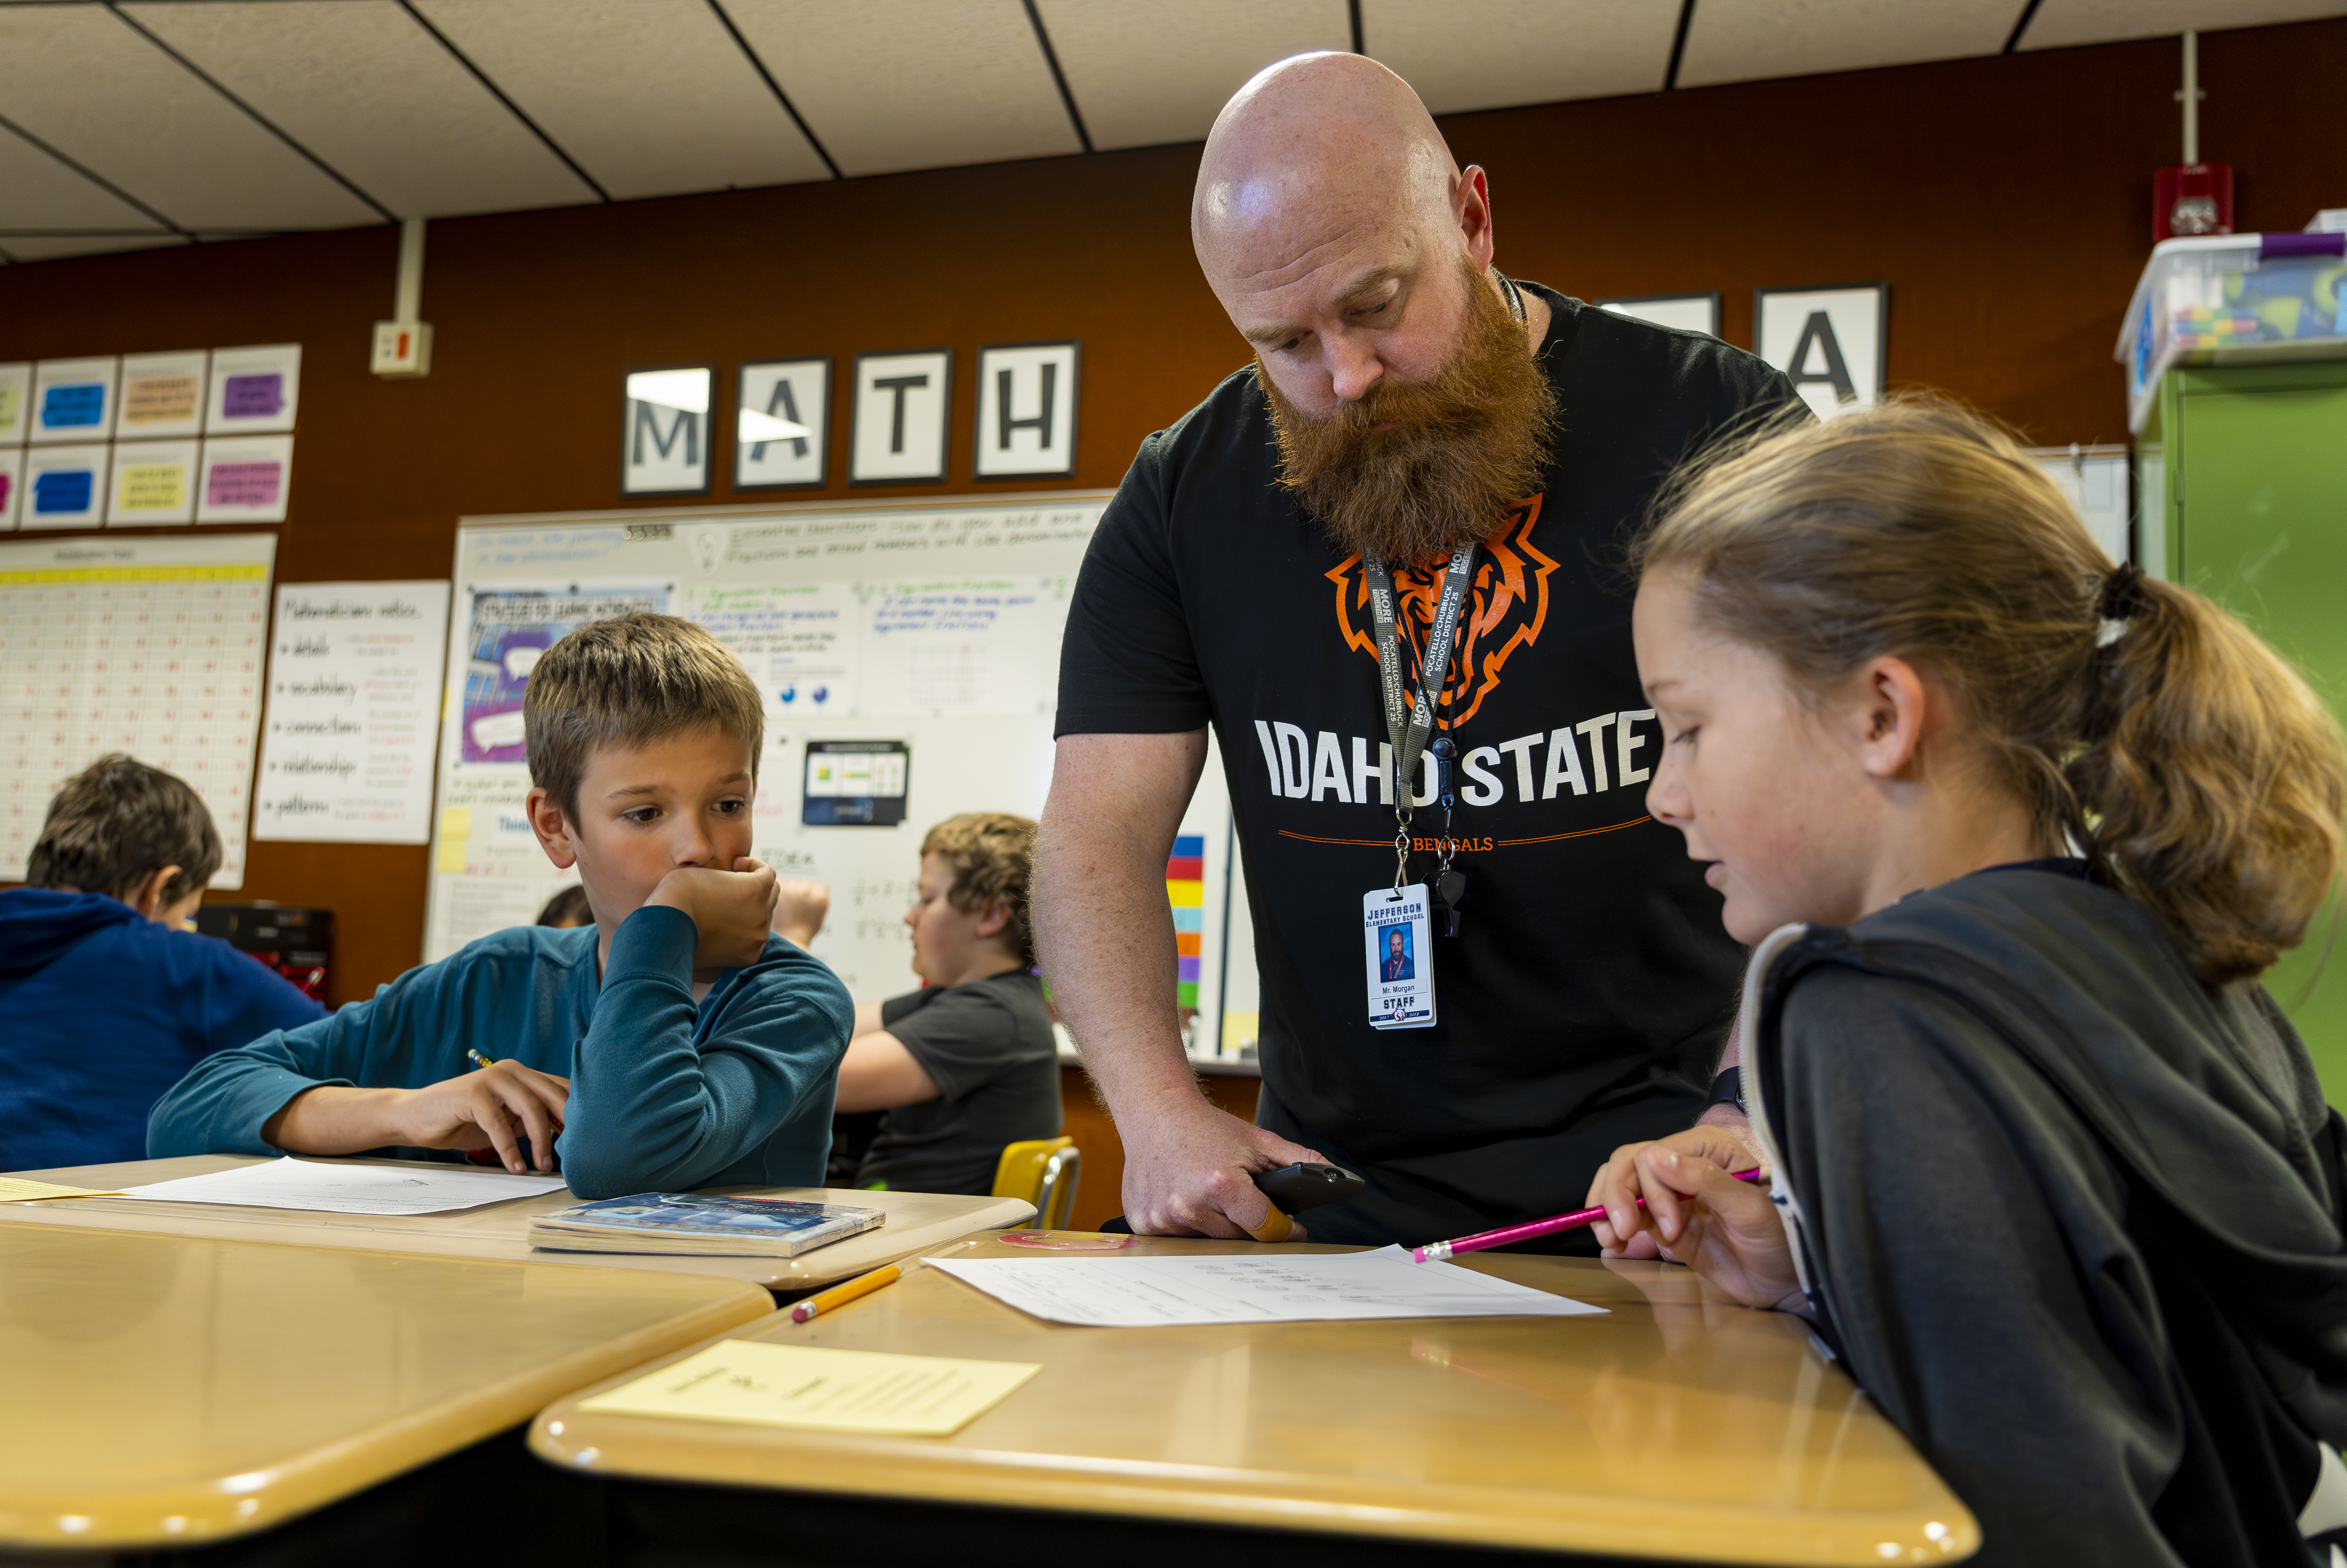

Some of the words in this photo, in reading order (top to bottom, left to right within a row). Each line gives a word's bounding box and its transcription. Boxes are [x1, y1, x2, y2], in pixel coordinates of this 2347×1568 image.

[1372, 589, 1384, 623] TOGETHER
[1379, 589, 1393, 624] MORE
[1425, 585, 1453, 677] POCATELLO/CHUBBUCK
[1435, 638, 1448, 672] SCHOOL
[1443, 601, 1456, 637] DISTRICT
[1451, 592, 1459, 601] 25
[1382, 642, 1391, 675] SCHOOL
[1386, 676, 1396, 712] DISTRICT
[1388, 636, 1403, 728] POCATELLO/CHUBBUCK
[1390, 713, 1396, 722] 25
[1254, 720, 1439, 807] IDAHO
[1461, 708, 1656, 807] STATE
[1412, 836, 1494, 852] BENGALS
[1366, 916, 1400, 928] ELEMENTARY
[1402, 913, 1424, 922] SCHOOL
[1367, 902, 1422, 920] JEFFERSON
[1383, 996, 1415, 1010] STAFF
[1392, 985, 1415, 993] Morgan
